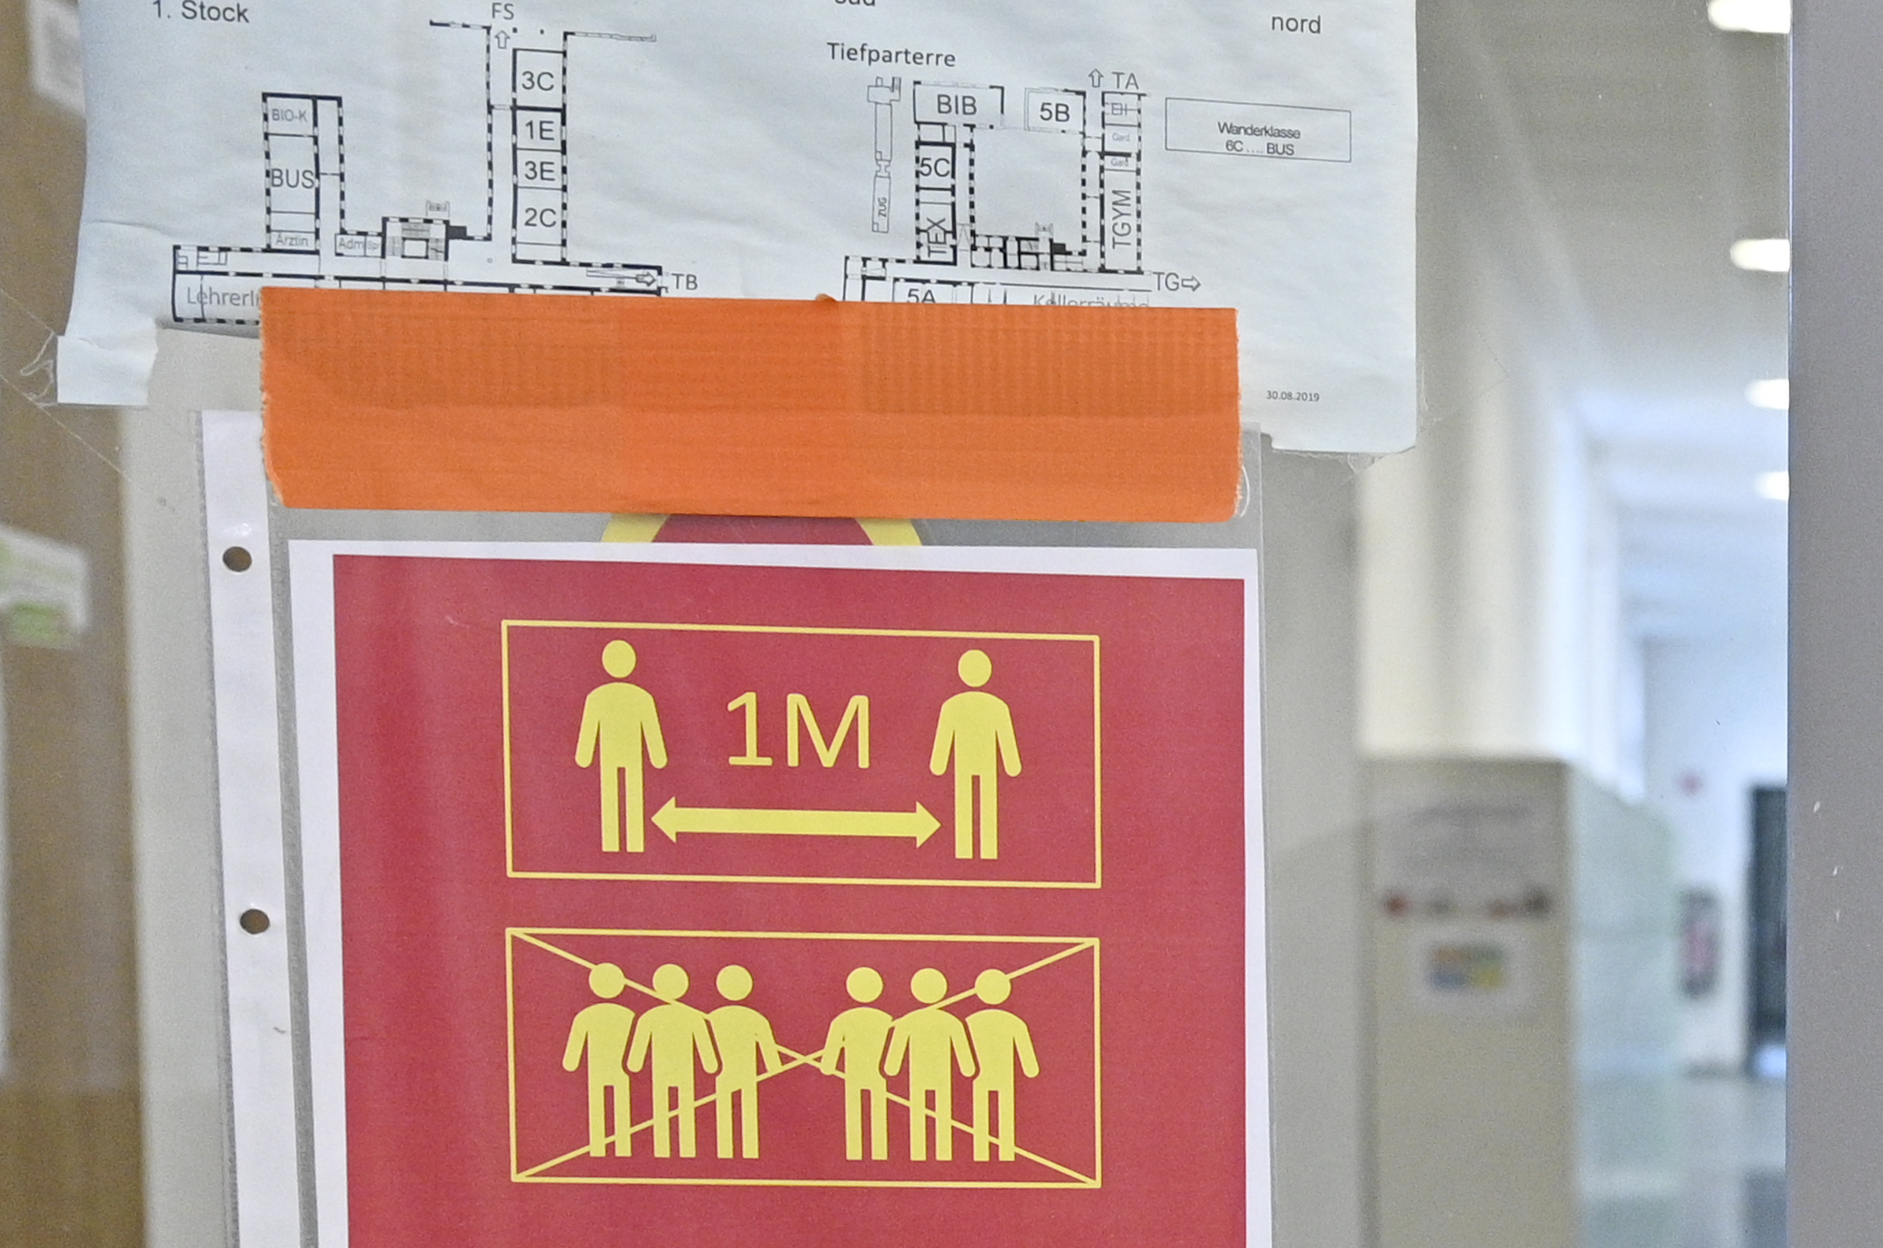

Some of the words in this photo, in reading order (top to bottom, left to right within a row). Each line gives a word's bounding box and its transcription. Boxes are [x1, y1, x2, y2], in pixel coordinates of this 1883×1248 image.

[181, 0, 250, 23] Stock
[491, 2, 514, 20] FS
[1271, 14, 1322, 34] nord
[826, 42, 956, 67] Tiefparterre
[521, 71, 555, 91] 3C
[1111, 71, 1139, 90] TA
[936, 94, 977, 115] BIB
[1039, 102, 1070, 122] 5B
[271, 108, 308, 123] BIO-K
[525, 120, 555, 141] 1E
[1217, 121, 1301, 139] Wanderklasse
[1266, 142, 1295, 156] BUS
[524, 161, 556, 181] 3E
[919, 157, 951, 177] 5C
[271, 168, 315, 189] BUS
[524, 207, 557, 228] 2C
[1111, 189, 1132, 250] TGYM
[671, 273, 698, 291] TB
[1152, 271, 1180, 291] TG
[907, 288, 936, 303] 5A
[1266, 390, 1320, 402] 30.08.2019
[727, 691, 870, 769] 1M
